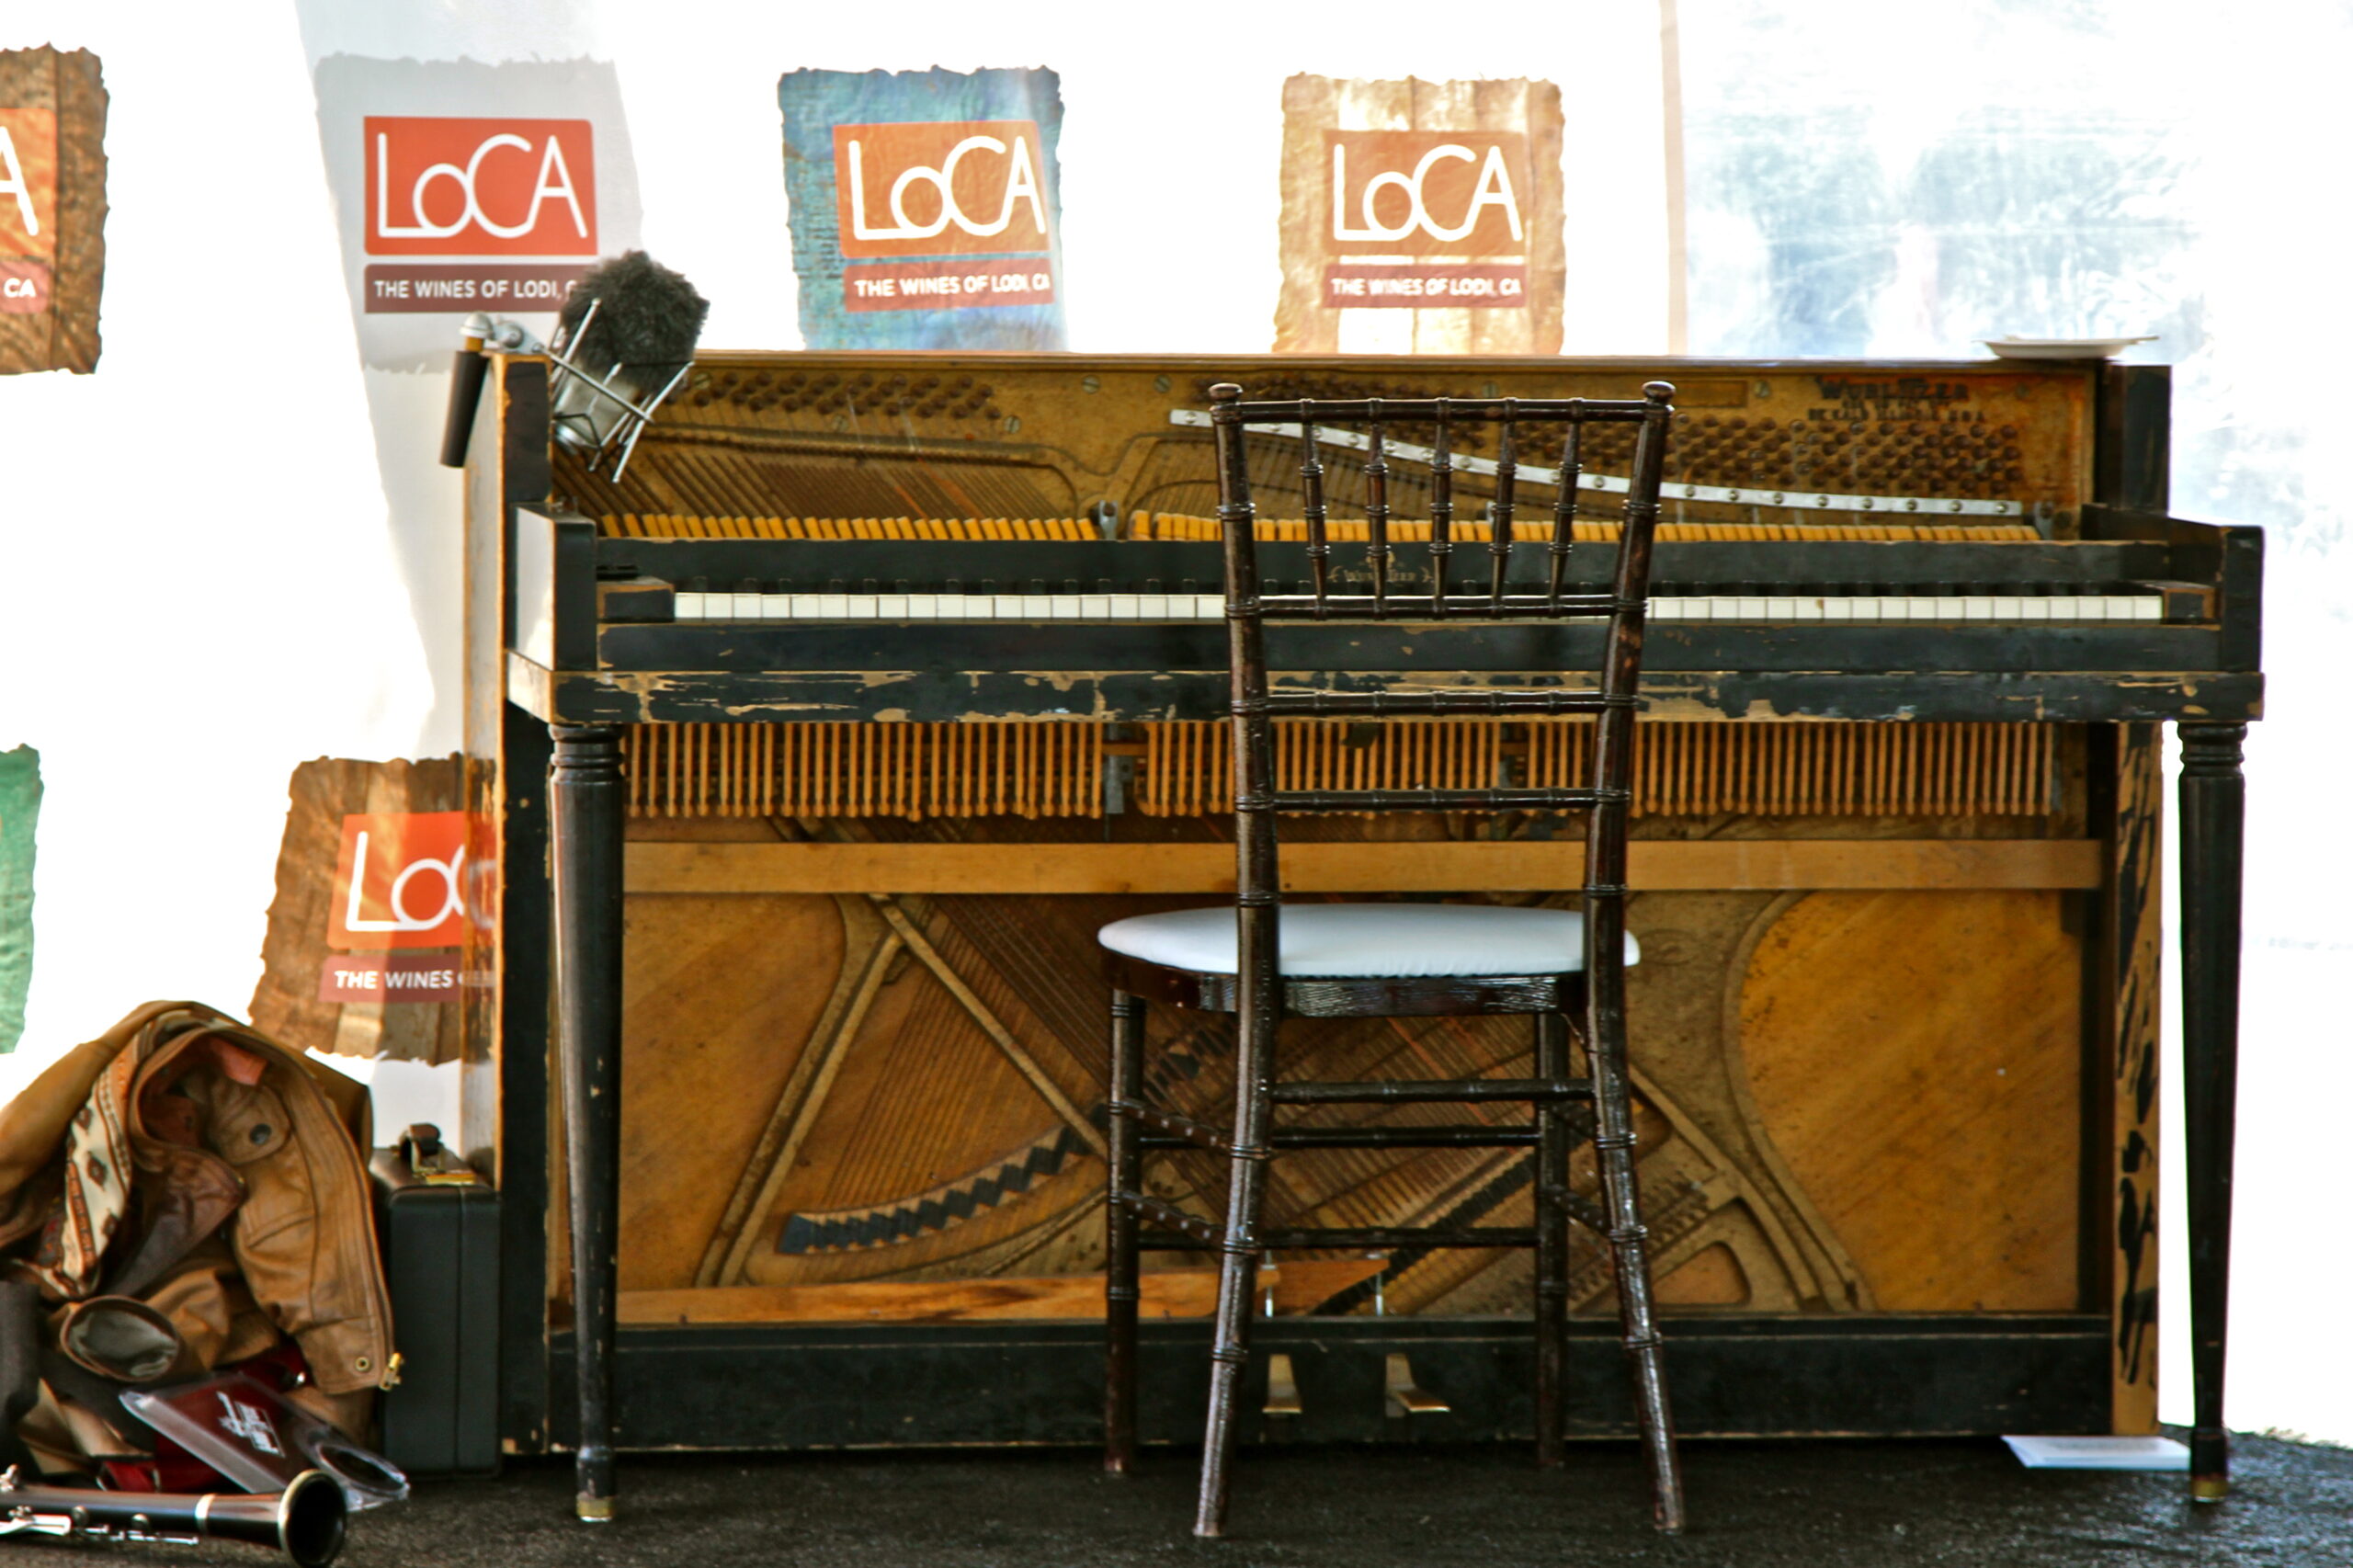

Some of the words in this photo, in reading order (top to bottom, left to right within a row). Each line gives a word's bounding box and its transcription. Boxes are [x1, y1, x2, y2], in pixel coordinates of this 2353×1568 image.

[374, 280, 410, 298] THE
[414, 280, 475, 298] WINES
[481, 279, 509, 299] OF
[854, 278, 895, 297] THE
[899, 276, 961, 295] WINES
[963, 275, 989, 293] OF
[1331, 278, 1366, 295] THE
[1368, 278, 1423, 296] WINES
[1425, 278, 1449, 295] OF
[335, 971, 378, 989] THE
[384, 970, 453, 989] WINES
